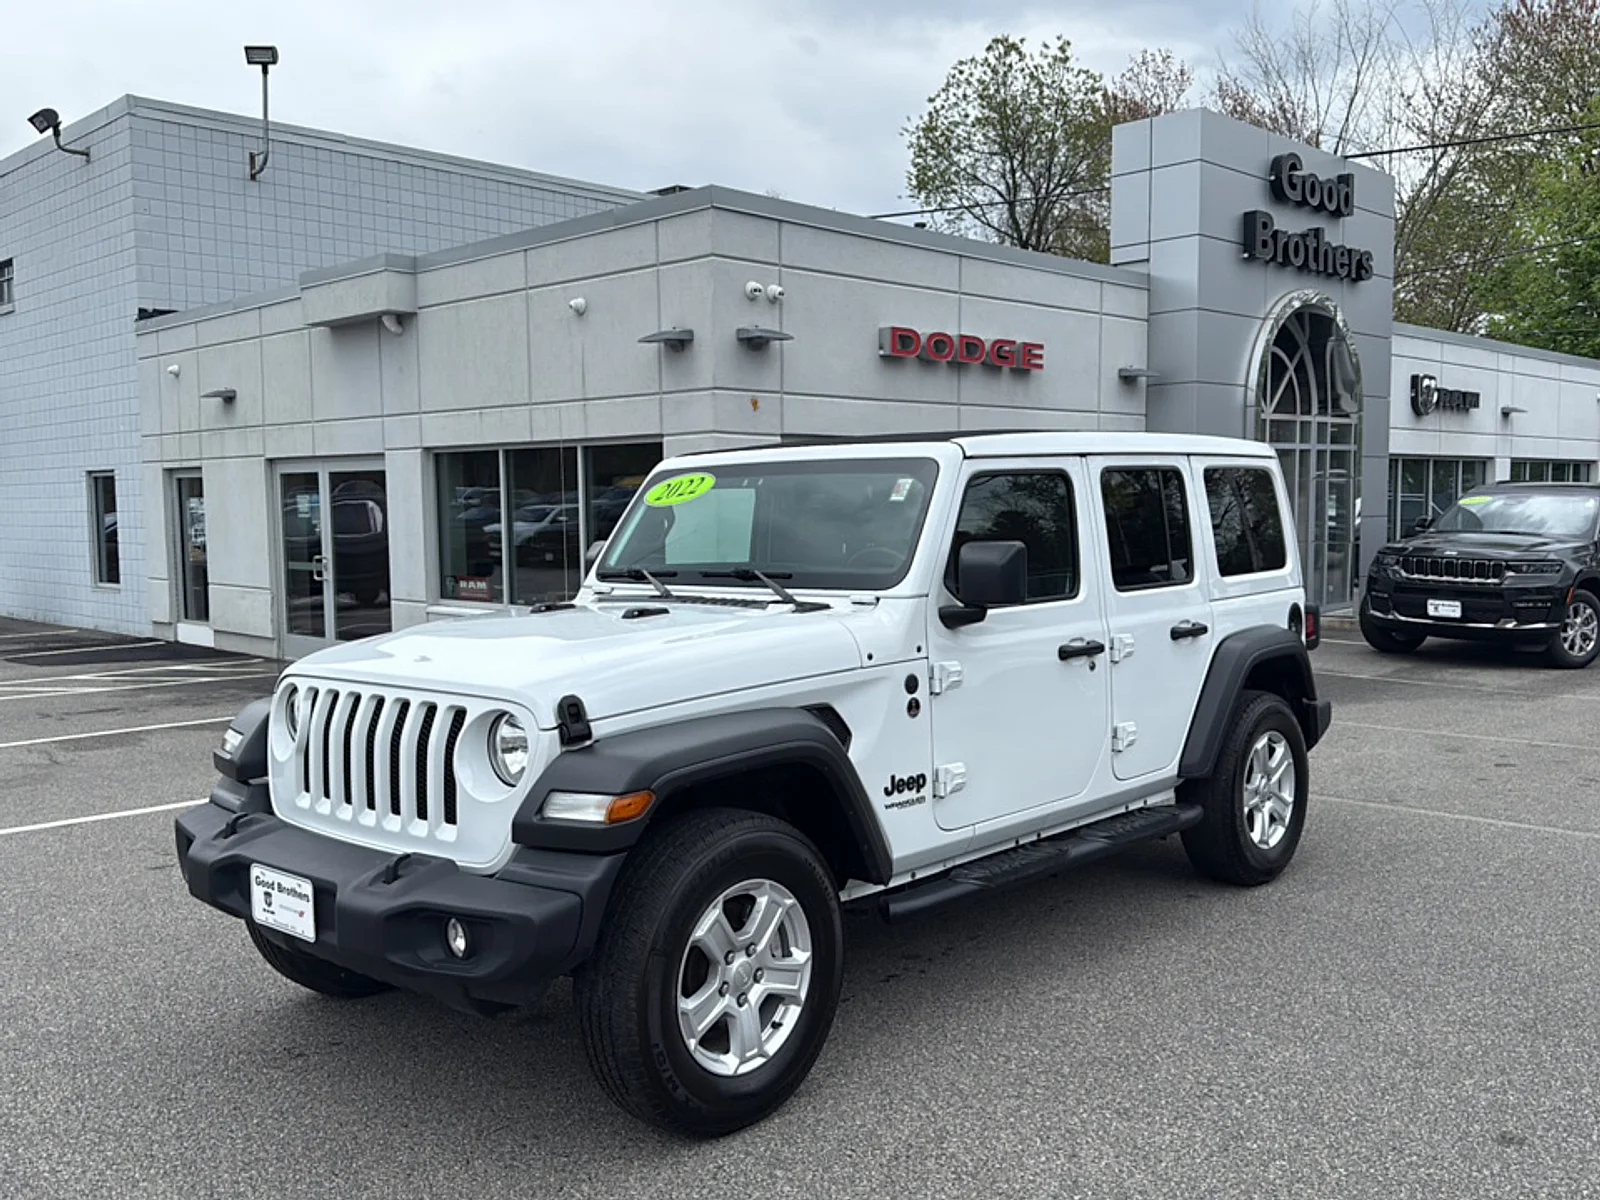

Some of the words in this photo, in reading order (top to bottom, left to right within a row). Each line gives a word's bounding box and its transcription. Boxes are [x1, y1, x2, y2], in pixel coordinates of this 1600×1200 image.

[1270, 152, 1354, 217] Good
[1244, 210, 1373, 280] Brothers
[880, 326, 1044, 370] DODGE
[655, 477, 705, 500] 2022
[884, 773, 926, 797] Jeep
[255, 875, 275, 891] Good
[277, 882, 310, 902] Brothers
